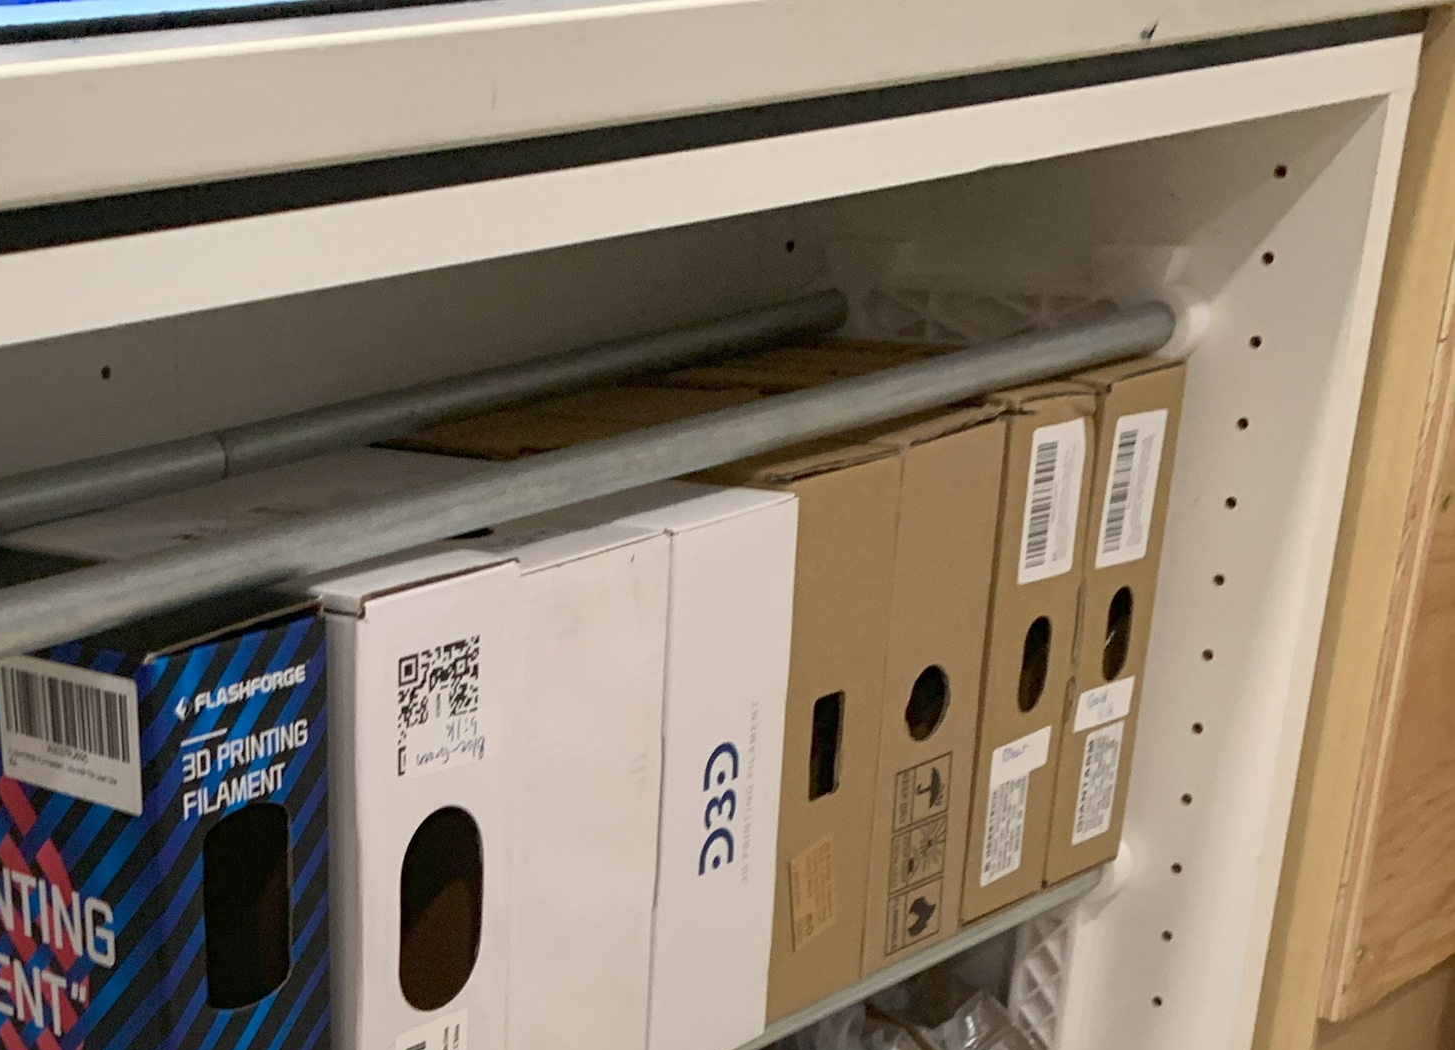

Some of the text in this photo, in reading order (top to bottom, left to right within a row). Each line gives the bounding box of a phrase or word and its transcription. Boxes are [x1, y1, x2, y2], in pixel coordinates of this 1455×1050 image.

[194, 664, 307, 714] FLASHFORGE
[181, 718, 310, 784] 3D PRINTING
[747, 701, 760, 780] FILAMENT
[182, 762, 287, 821] FILAMENT
